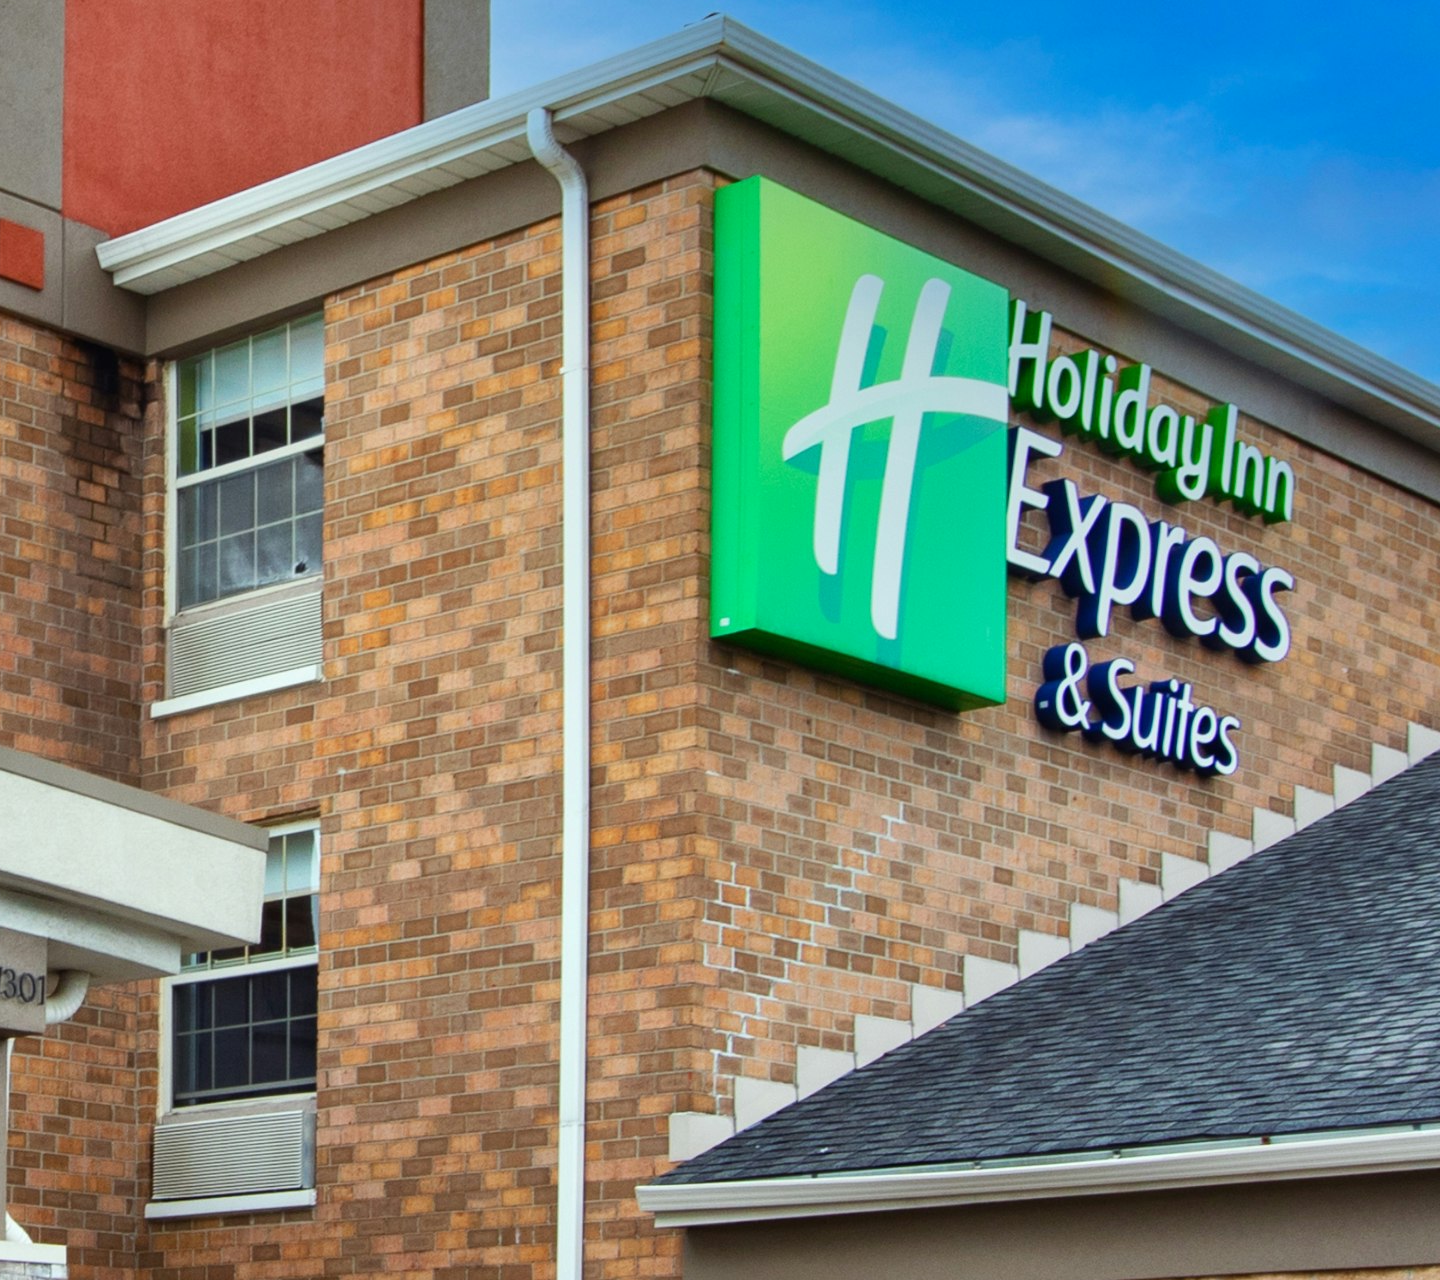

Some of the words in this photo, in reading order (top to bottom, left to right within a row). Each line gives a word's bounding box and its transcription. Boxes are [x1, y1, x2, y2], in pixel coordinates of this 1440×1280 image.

[1008, 298, 1214, 502] Holiday
[1221, 402, 1295, 523] Inn
[1006, 425, 1295, 662] Express
[1055, 641, 1091, 730] &
[1101, 656, 1241, 775] Suites
